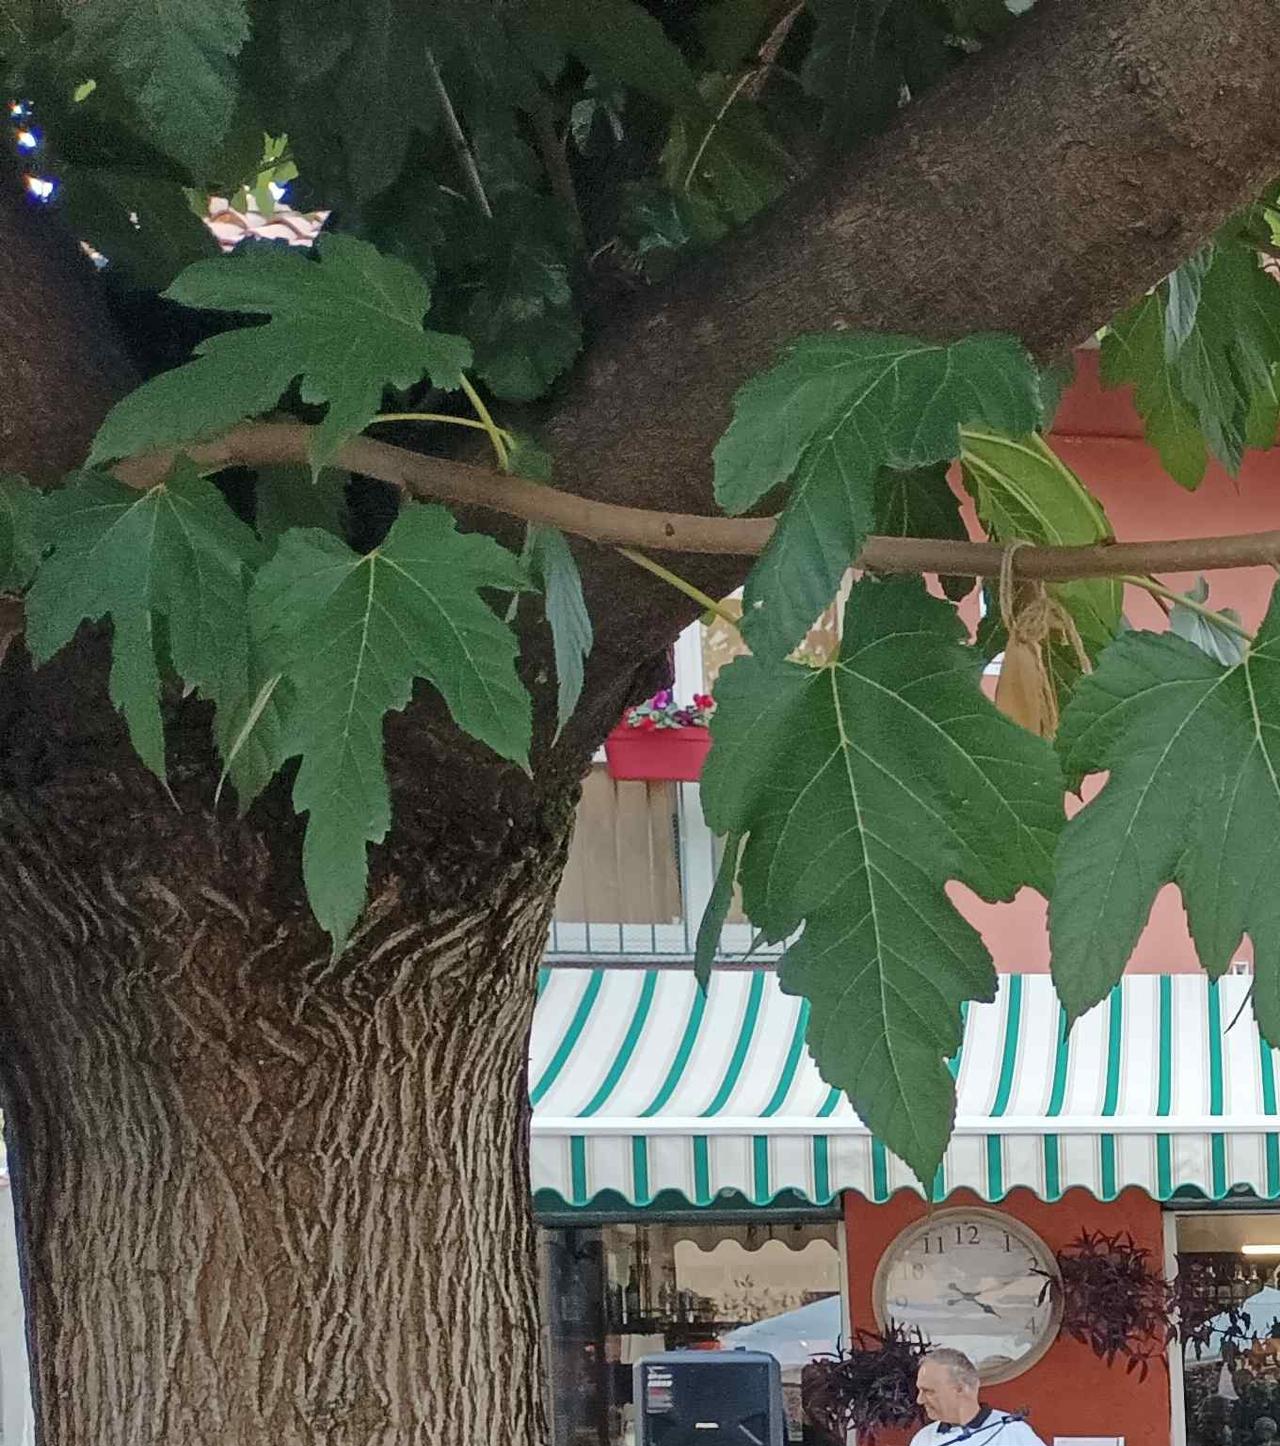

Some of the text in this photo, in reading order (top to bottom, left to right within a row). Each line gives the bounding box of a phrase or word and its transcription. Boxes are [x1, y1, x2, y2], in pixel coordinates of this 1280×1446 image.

[923, 1236, 944, 1254] 11
[955, 1226, 980, 1245] 12
[1003, 1232, 1011, 1253] 1
